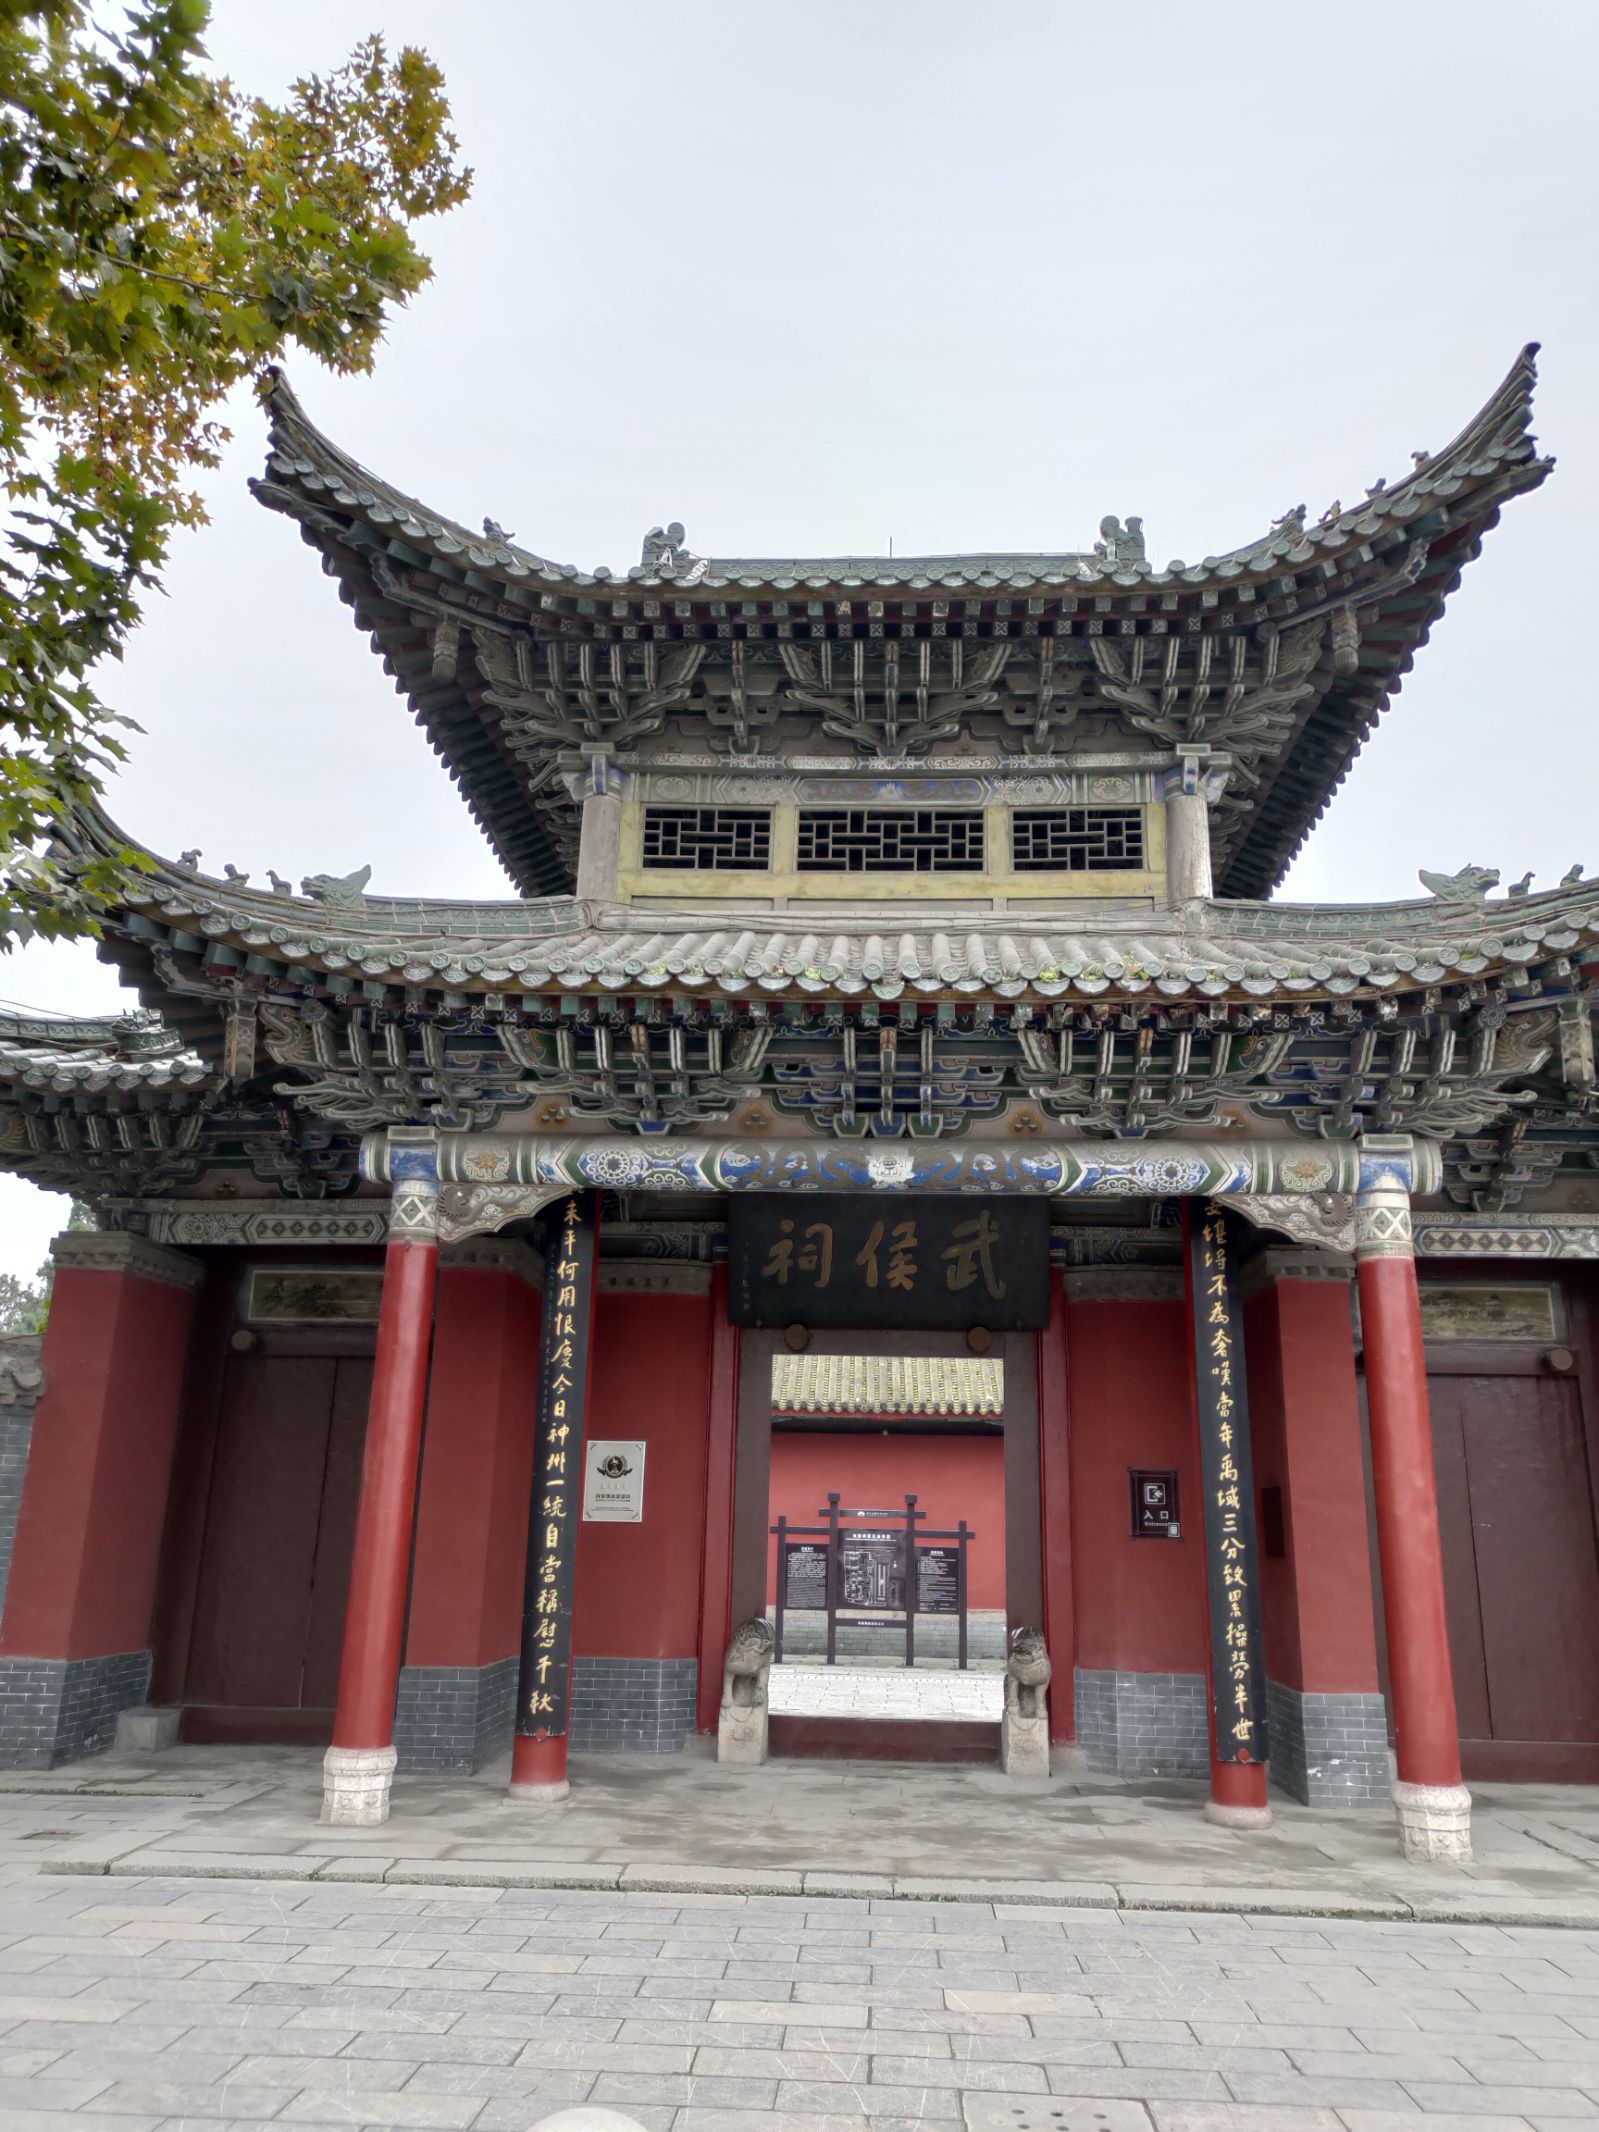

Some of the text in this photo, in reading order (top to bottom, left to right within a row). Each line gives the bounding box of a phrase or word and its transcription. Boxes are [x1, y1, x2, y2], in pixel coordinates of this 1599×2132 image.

[761, 1209, 1006, 1300] 武侯祠
[529, 1187, 584, 1715] 未平何用恨慶今日神州一統自當稱慰千秋
[1144, 1510, 1169, 1520] 入口
